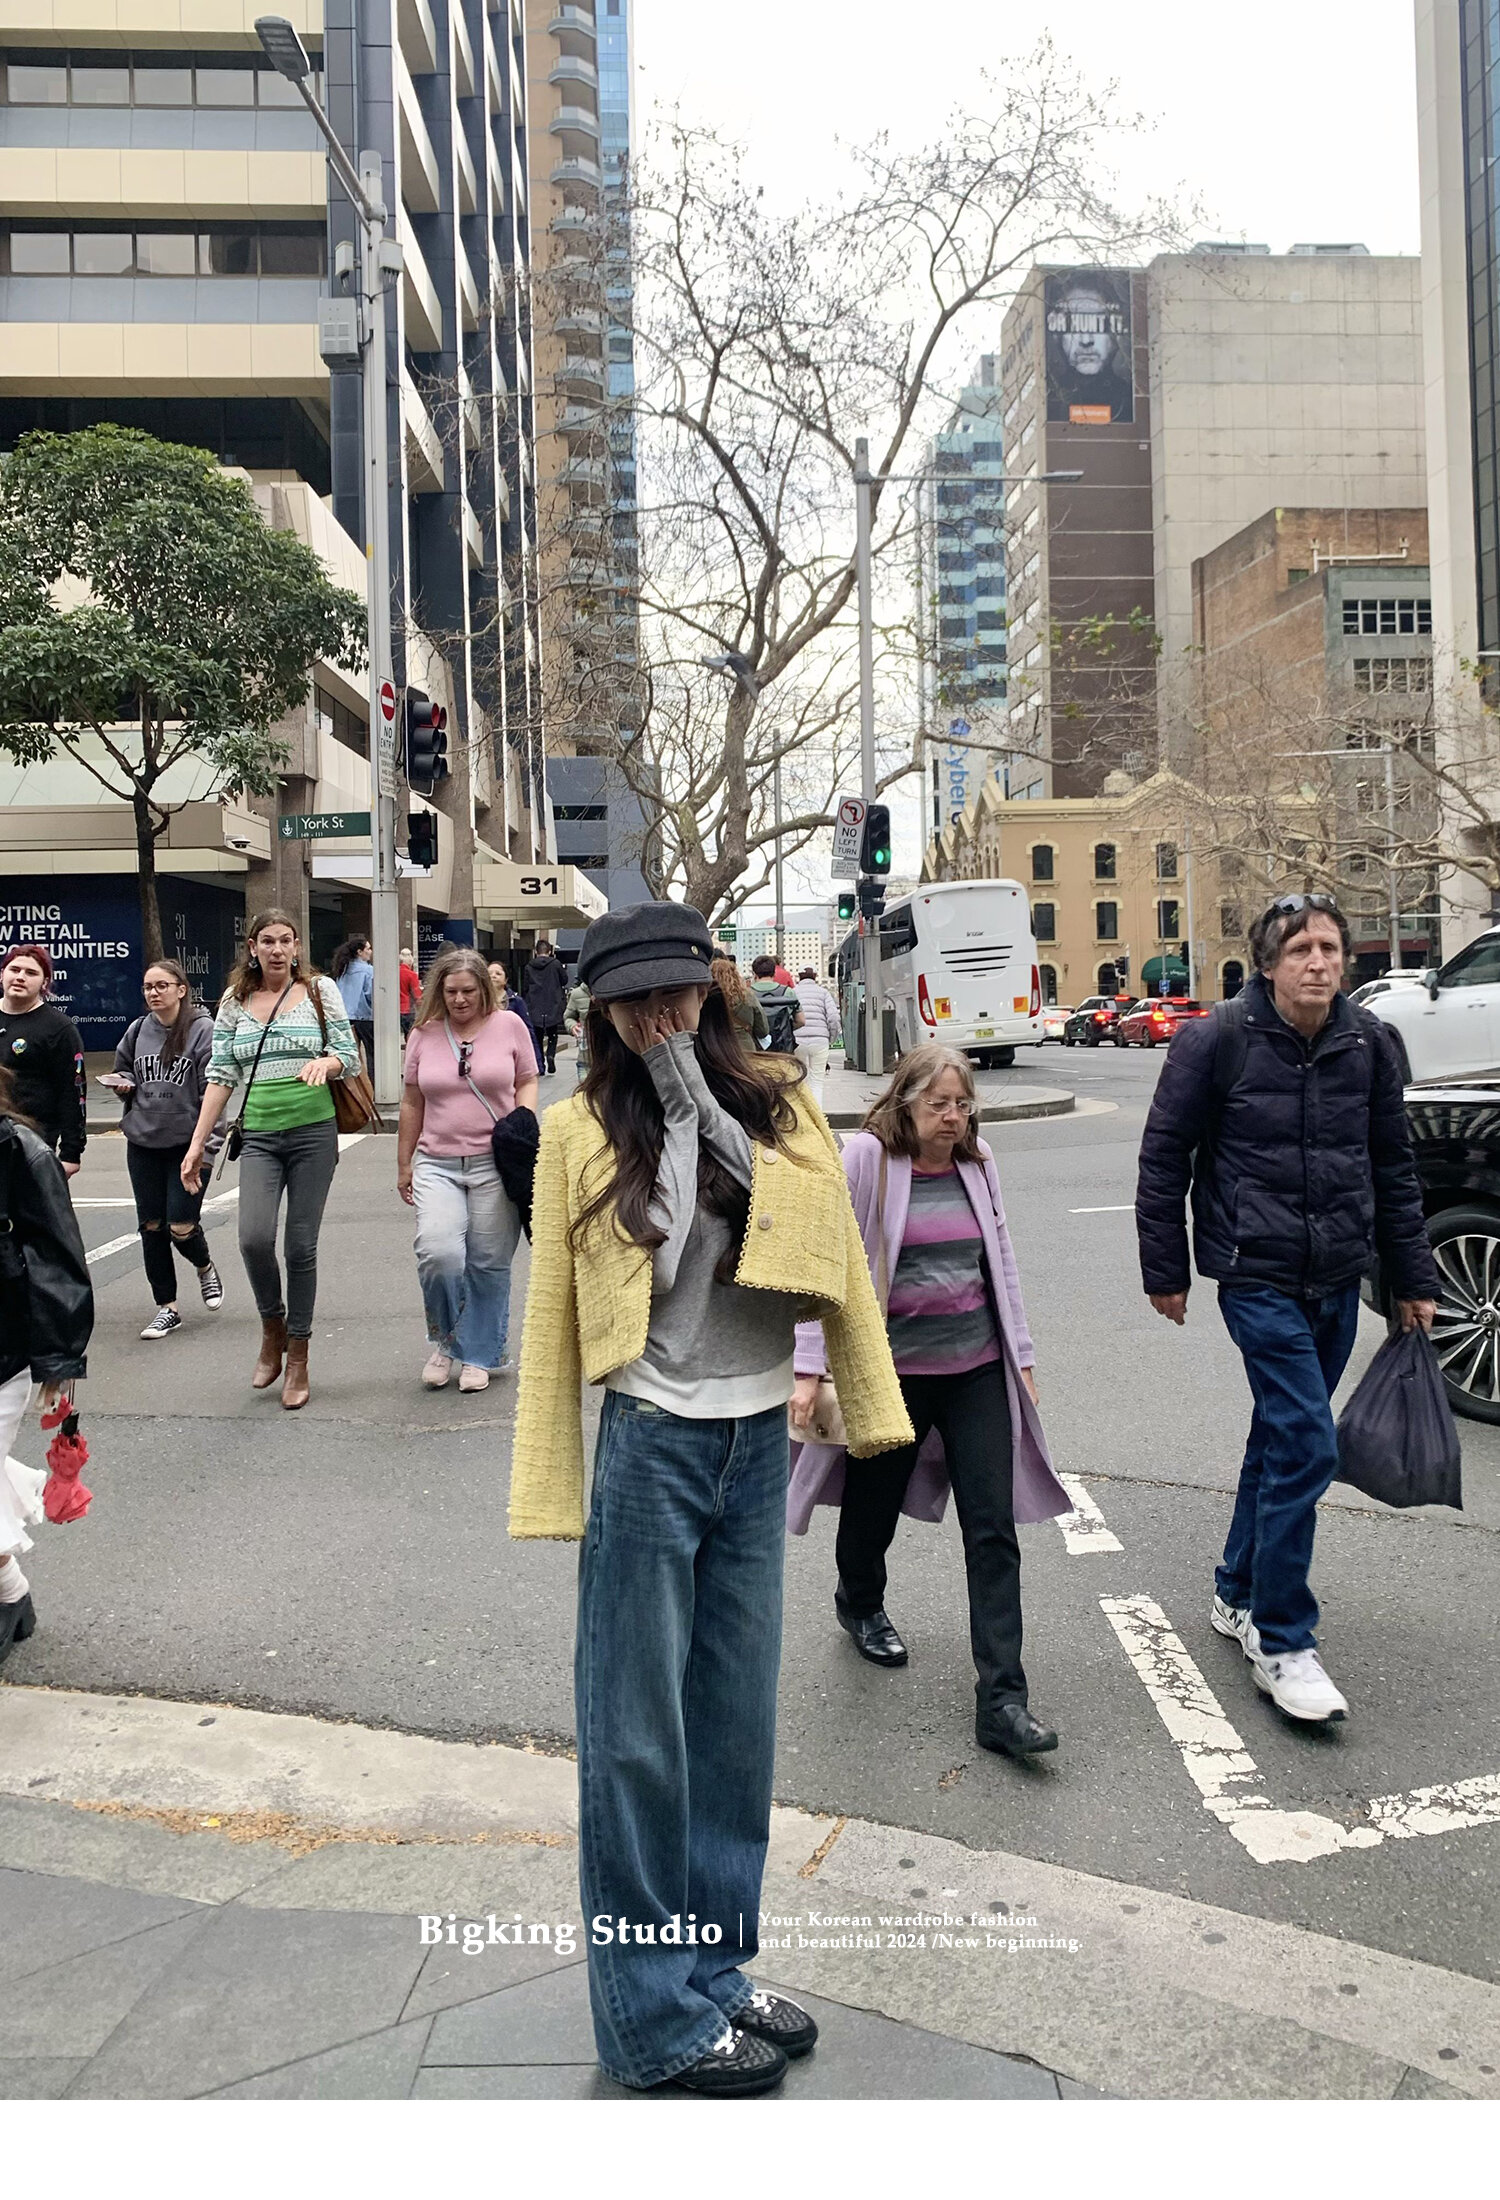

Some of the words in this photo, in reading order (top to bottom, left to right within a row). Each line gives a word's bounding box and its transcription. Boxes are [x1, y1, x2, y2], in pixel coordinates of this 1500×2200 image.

[1070, 313, 1105, 333] HUNT
[383, 726, 393, 739] NO
[380, 738, 394, 750] ENTRY
[301, 817, 329, 830] York
[331, 816, 344, 828] St
[841, 827, 857, 838] NO
[838, 838, 857, 847] LEFT
[837, 847, 857, 856] TURN
[520, 877, 558, 895] 31
[20, 923, 91, 941] RETAIL
[175, 913, 186, 940] 31
[176, 946, 209, 974] Market
